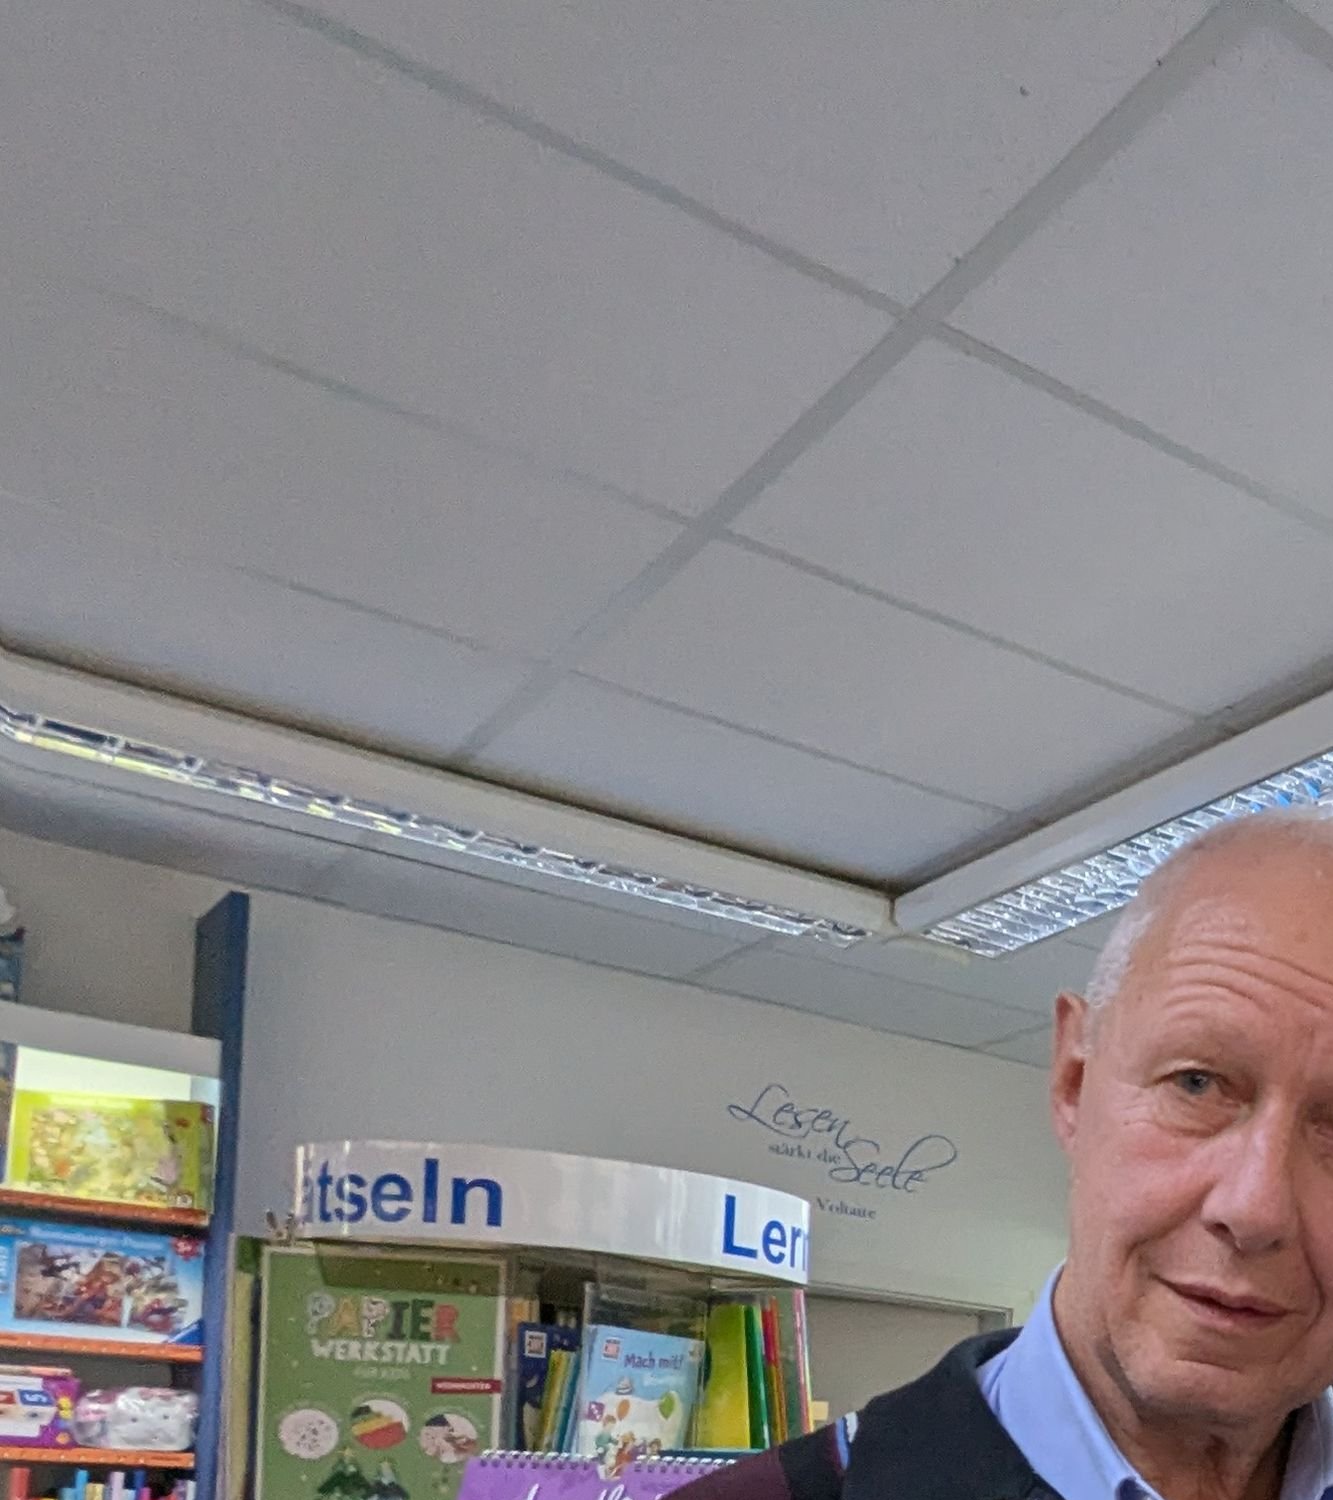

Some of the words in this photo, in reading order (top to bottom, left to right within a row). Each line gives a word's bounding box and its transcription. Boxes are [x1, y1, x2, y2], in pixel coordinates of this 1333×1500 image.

[727, 1083, 850, 1150] Lesen
[829, 1134, 957, 1193] Seele
[307, 1292, 461, 1343] PAPIER
[310, 1339, 450, 1365] WERKSTATT
[624, 1353, 654, 1369] Mach
